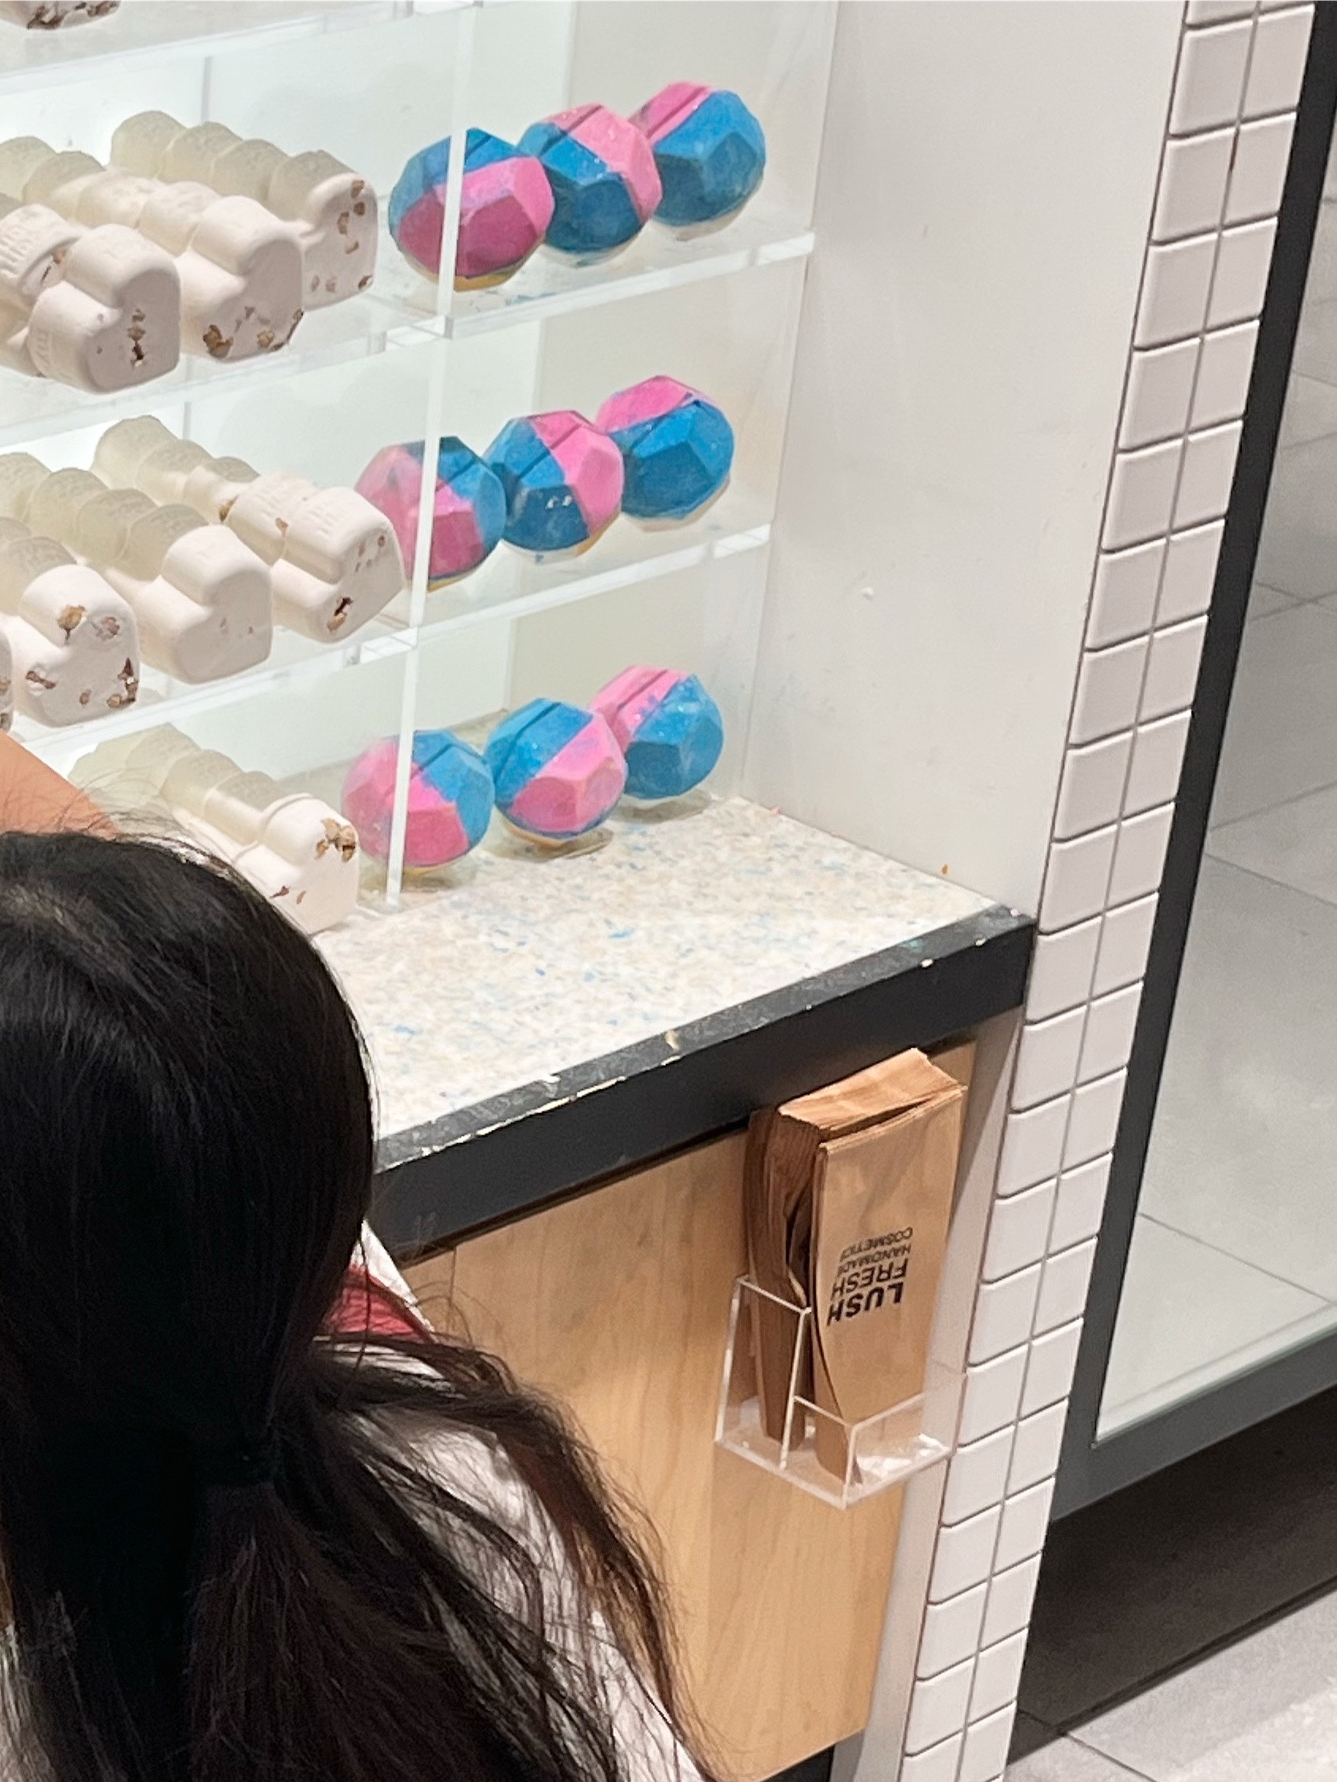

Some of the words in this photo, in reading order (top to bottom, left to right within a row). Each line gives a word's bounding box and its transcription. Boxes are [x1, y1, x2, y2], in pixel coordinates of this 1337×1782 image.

[831, 1257, 908, 1300] FRESH
[837, 1243, 912, 1277] HANDMADE
[827, 1281, 904, 1327] LUSH
